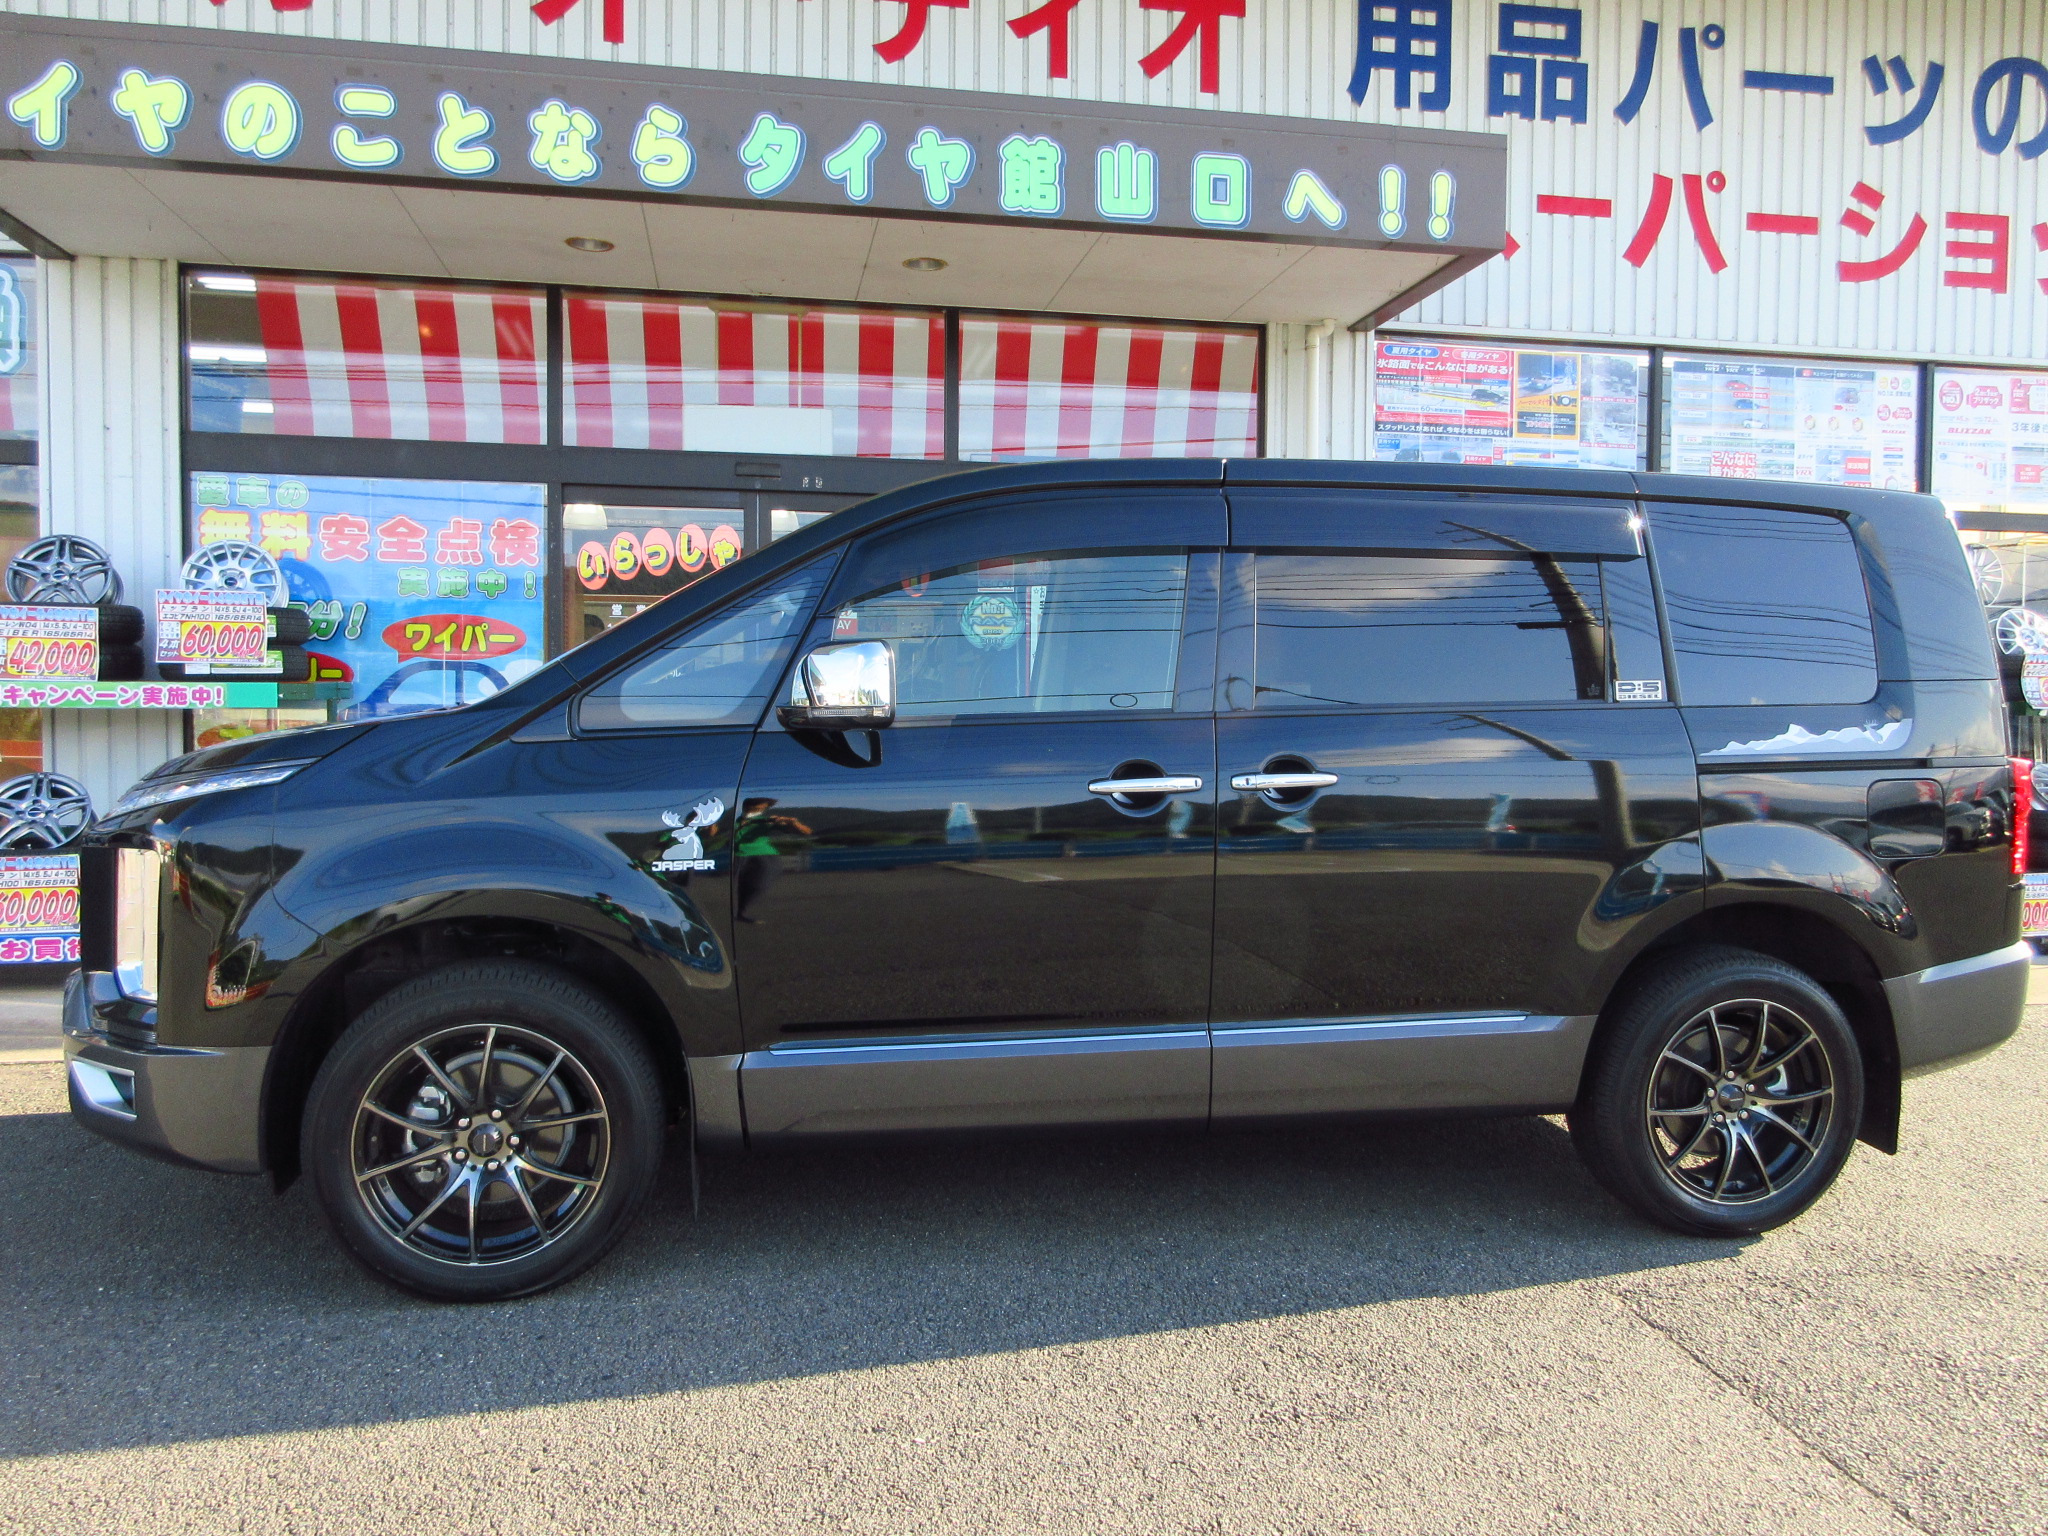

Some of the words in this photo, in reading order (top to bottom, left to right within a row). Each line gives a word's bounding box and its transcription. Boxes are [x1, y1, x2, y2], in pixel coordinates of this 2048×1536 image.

[1504, 168, 2048, 295] ーパーショ
[1947, 427, 1993, 436] BLIZZAK
[197, 476, 310, 508] 愛車の
[397, 567, 537, 599] 実施中!
[969, 616, 1016, 627] RAYS
[182, 623, 265, 657] 60,000
[404, 622, 518, 652] ワイパー
[8, 640, 96, 675] 42,000
[2, 685, 225, 706] キャンペーン実施中!
[1617, 682, 1660, 692] D:5
[651, 860, 716, 872] JASPER
